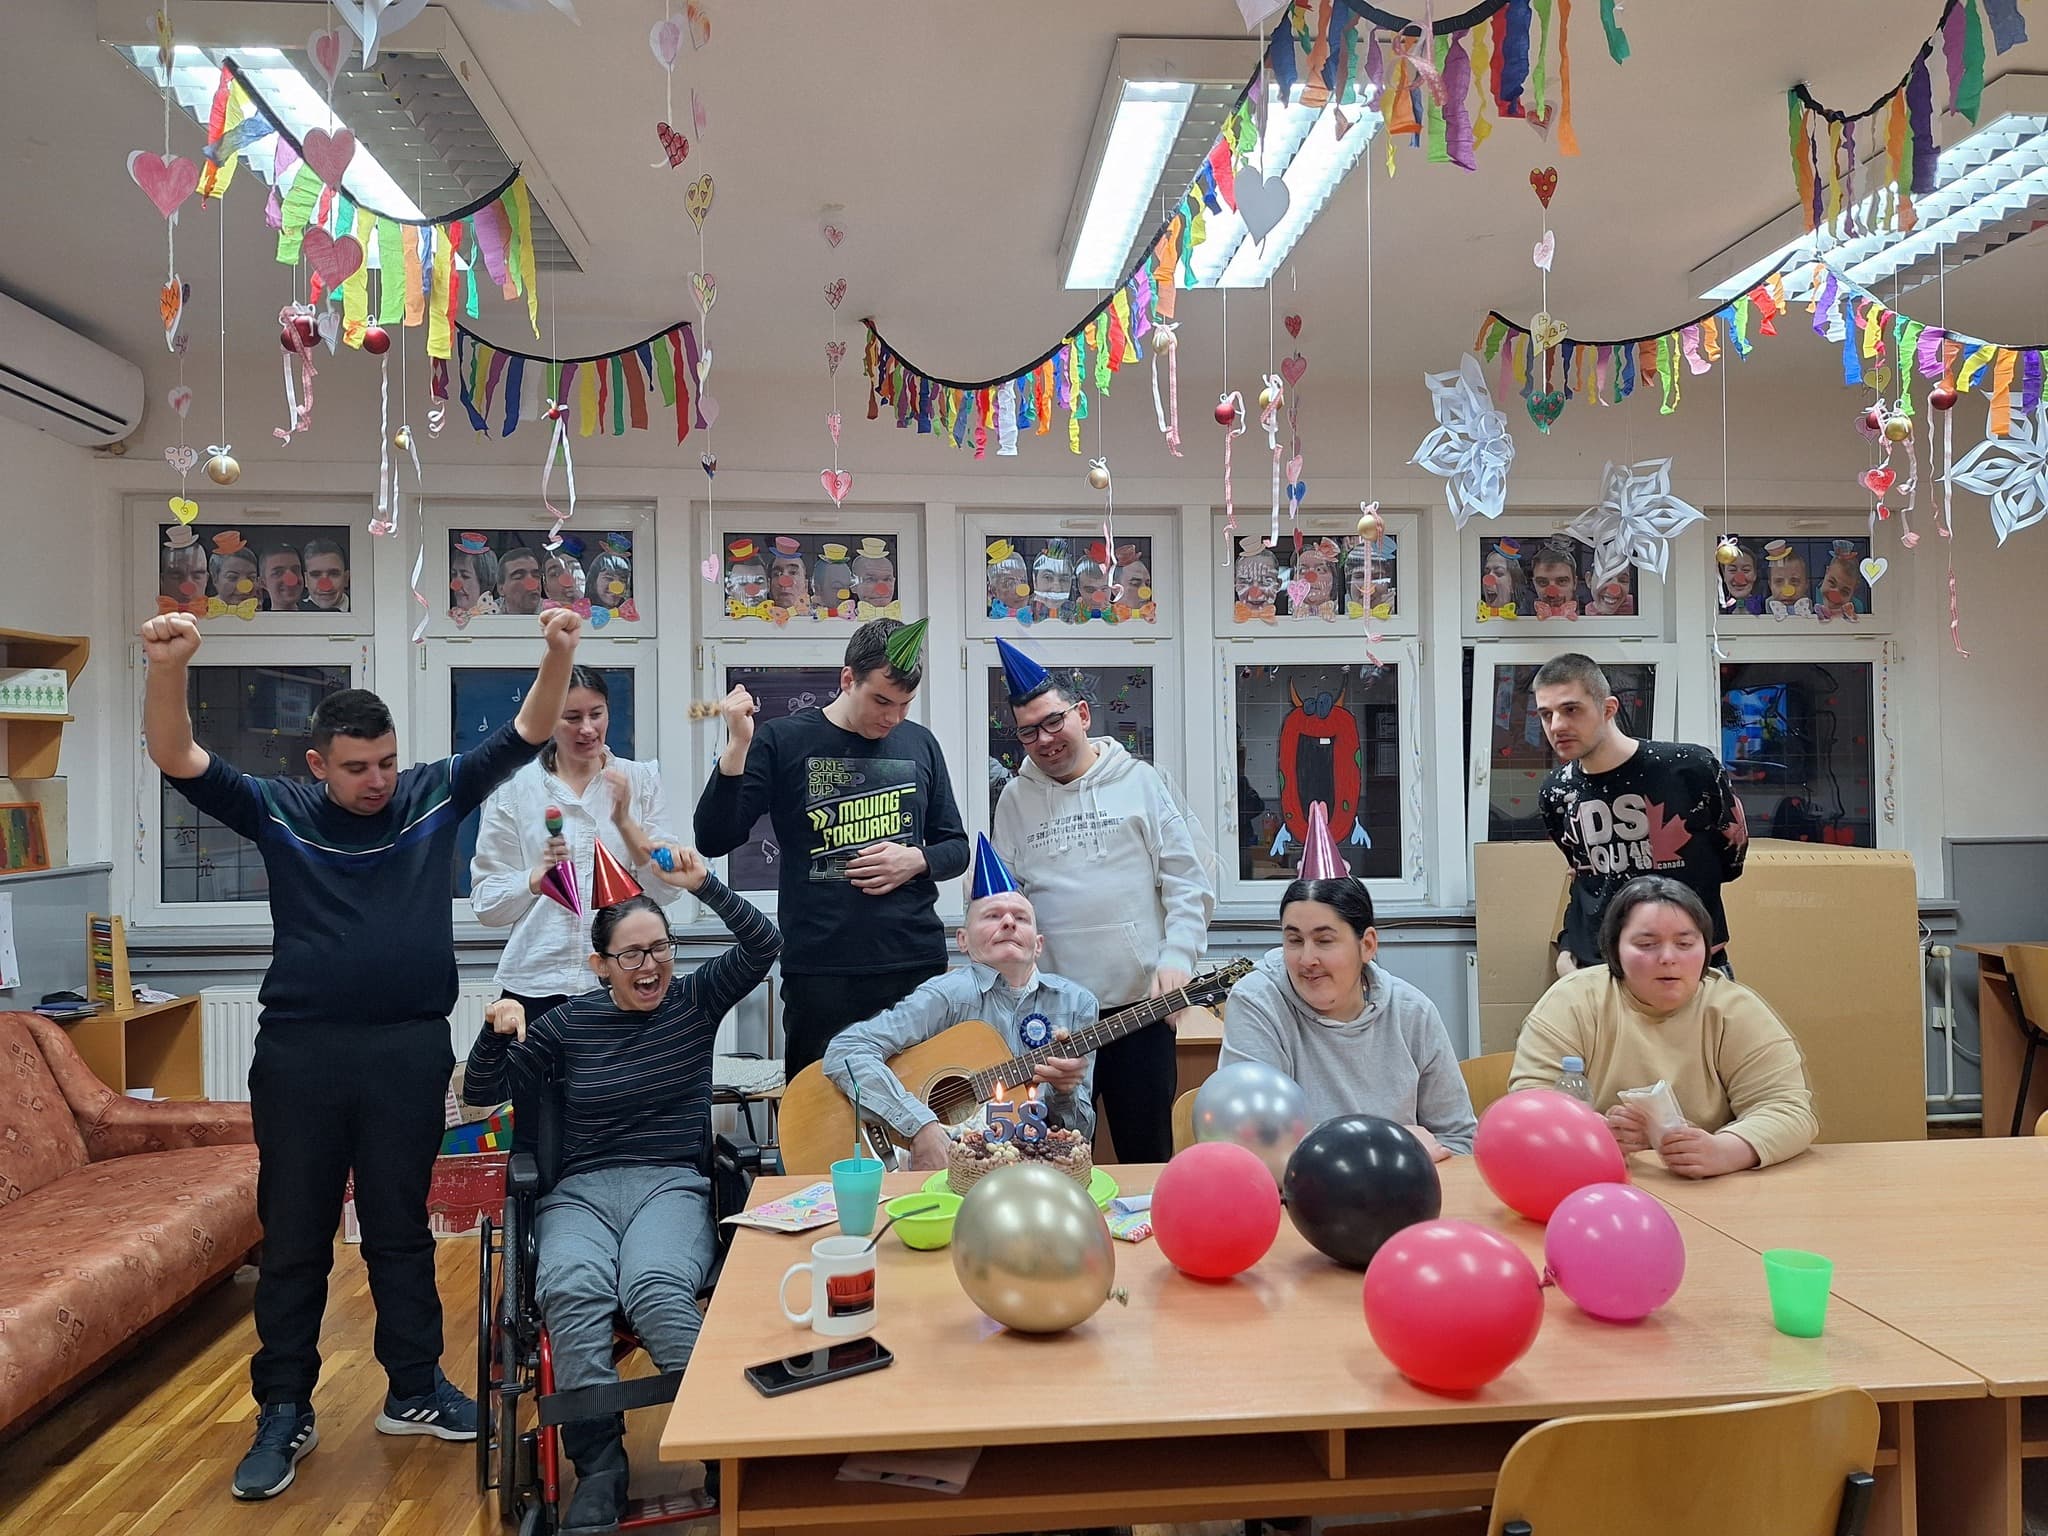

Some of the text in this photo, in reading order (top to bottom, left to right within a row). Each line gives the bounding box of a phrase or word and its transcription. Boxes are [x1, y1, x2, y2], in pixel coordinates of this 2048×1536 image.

[808, 759, 845, 773] ONE
[808, 772, 853, 785] STEP
[809, 783, 834, 796] UP
[822, 811, 901, 851] FORWARD
[1580, 793, 1650, 846] DS
[982, 1100, 1049, 1145] 58
